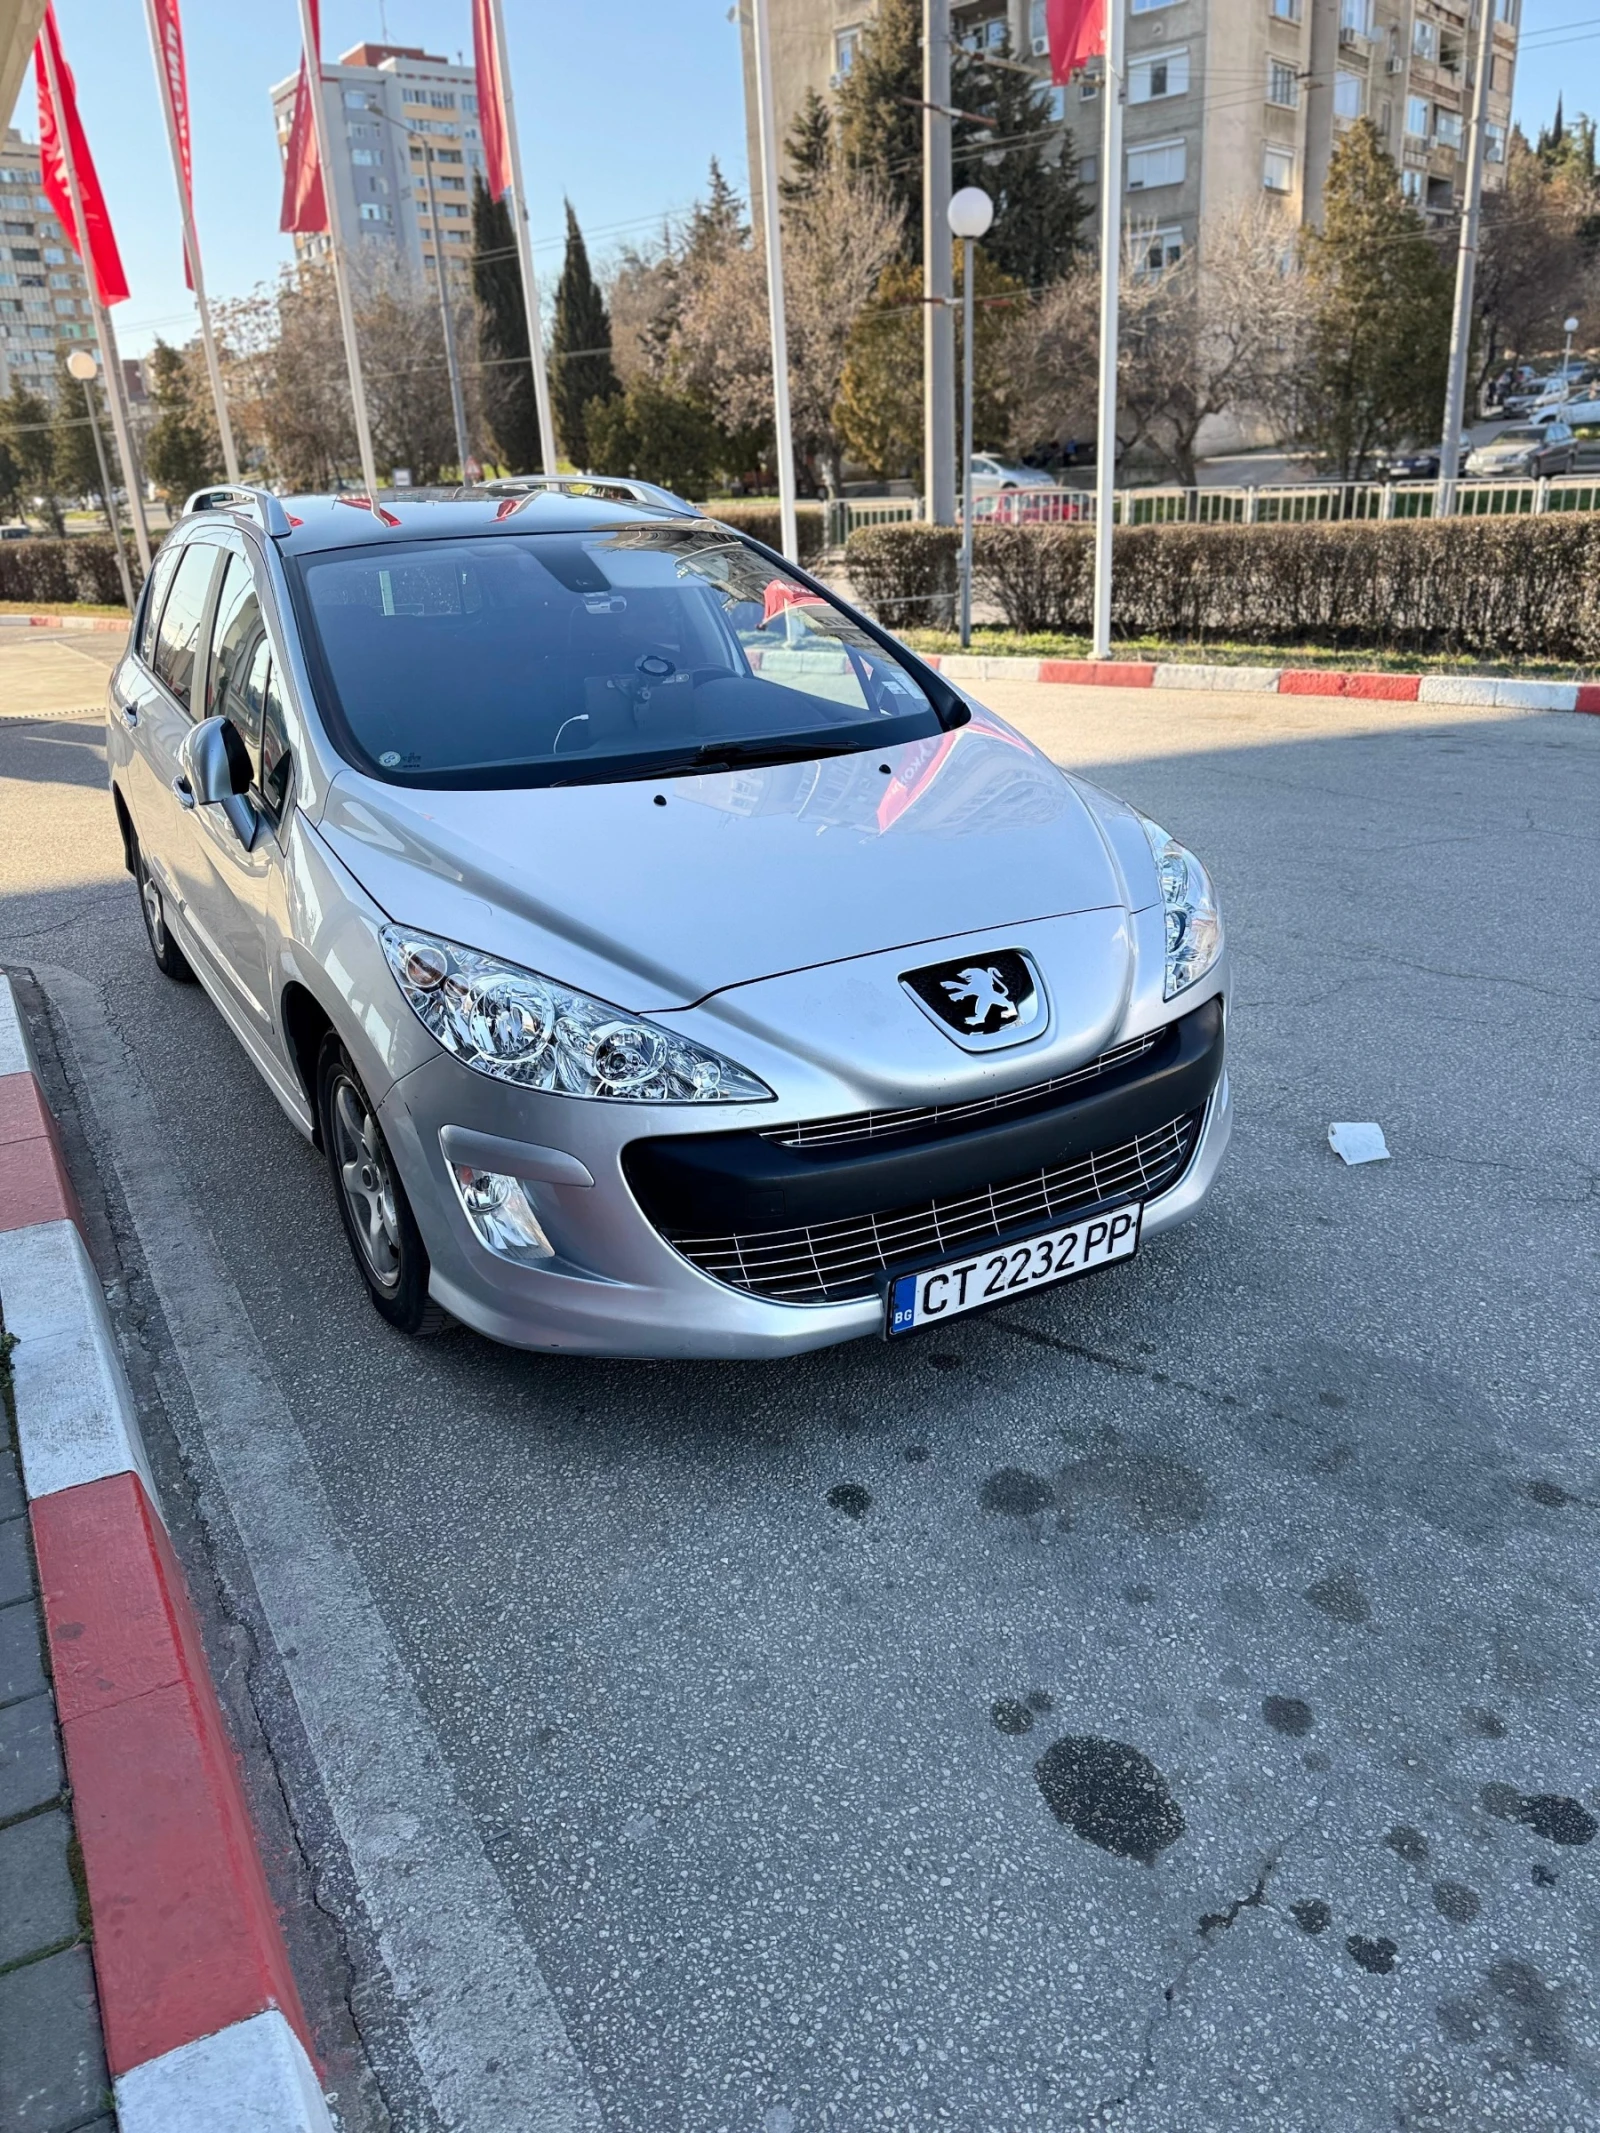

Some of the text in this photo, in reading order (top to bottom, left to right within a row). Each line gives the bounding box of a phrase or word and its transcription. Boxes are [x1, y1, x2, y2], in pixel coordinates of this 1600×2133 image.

[922, 1212, 1132, 1316] CT 2232 PP
[894, 1308, 913, 1324] BG
